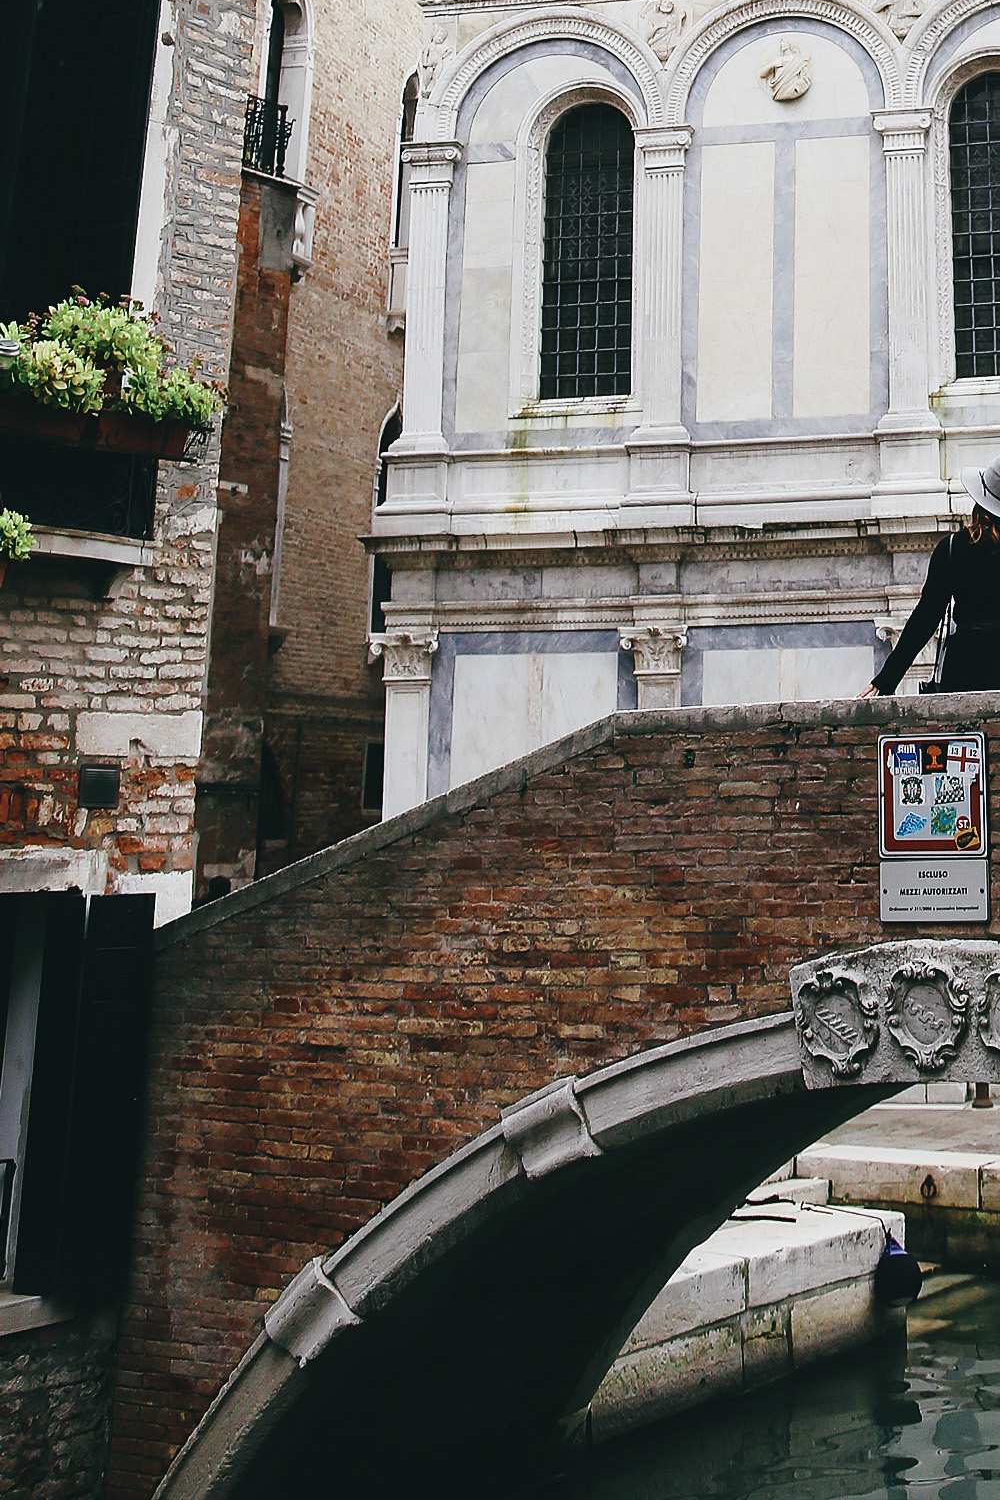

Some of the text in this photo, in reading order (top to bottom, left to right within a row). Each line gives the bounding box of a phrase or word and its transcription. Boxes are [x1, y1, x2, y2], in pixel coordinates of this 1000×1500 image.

[969, 749, 977, 757] 12
[958, 819, 969, 829] ST.
[918, 870, 948, 879] ESCLUSO
[900, 887, 968, 896] MEZZI AUTORIZZATI
